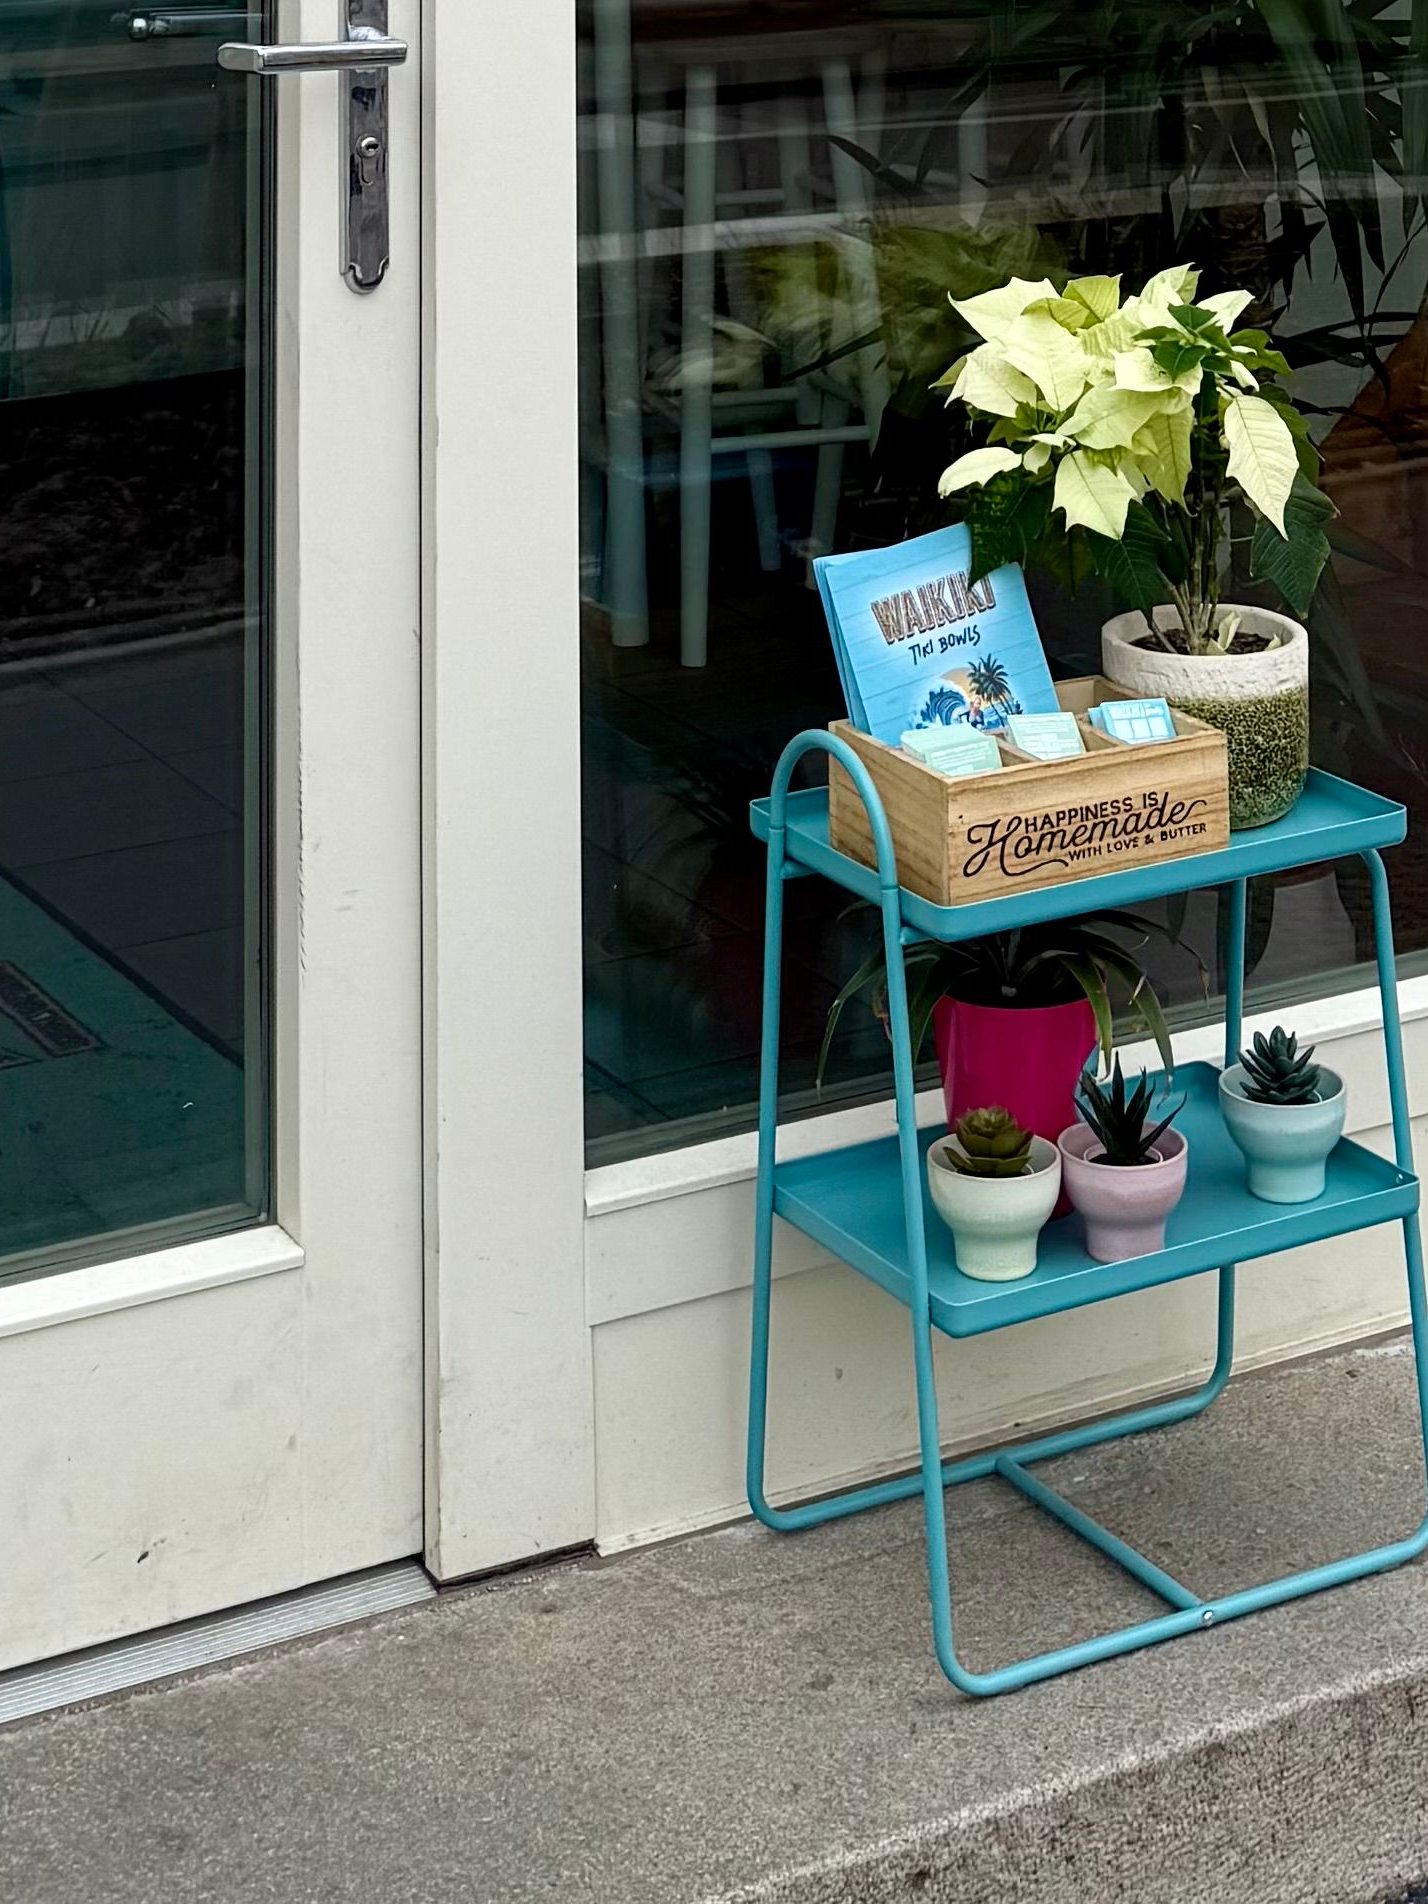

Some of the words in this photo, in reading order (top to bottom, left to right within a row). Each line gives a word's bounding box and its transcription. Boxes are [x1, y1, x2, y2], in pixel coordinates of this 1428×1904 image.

[871, 570, 996, 645] WAIKIKI
[908, 639, 934, 666] TIKI
[938, 624, 981, 654] BOWLS
[1024, 796, 1133, 834] HAPPINESS
[1142, 792, 1159, 808] IS
[963, 792, 1208, 878] Homemade
[1069, 845, 1102, 861] WITH
[1106, 837, 1139, 853] LOVE
[1144, 834, 1155, 845] &
[1160, 822, 1207, 842] BUTTER
